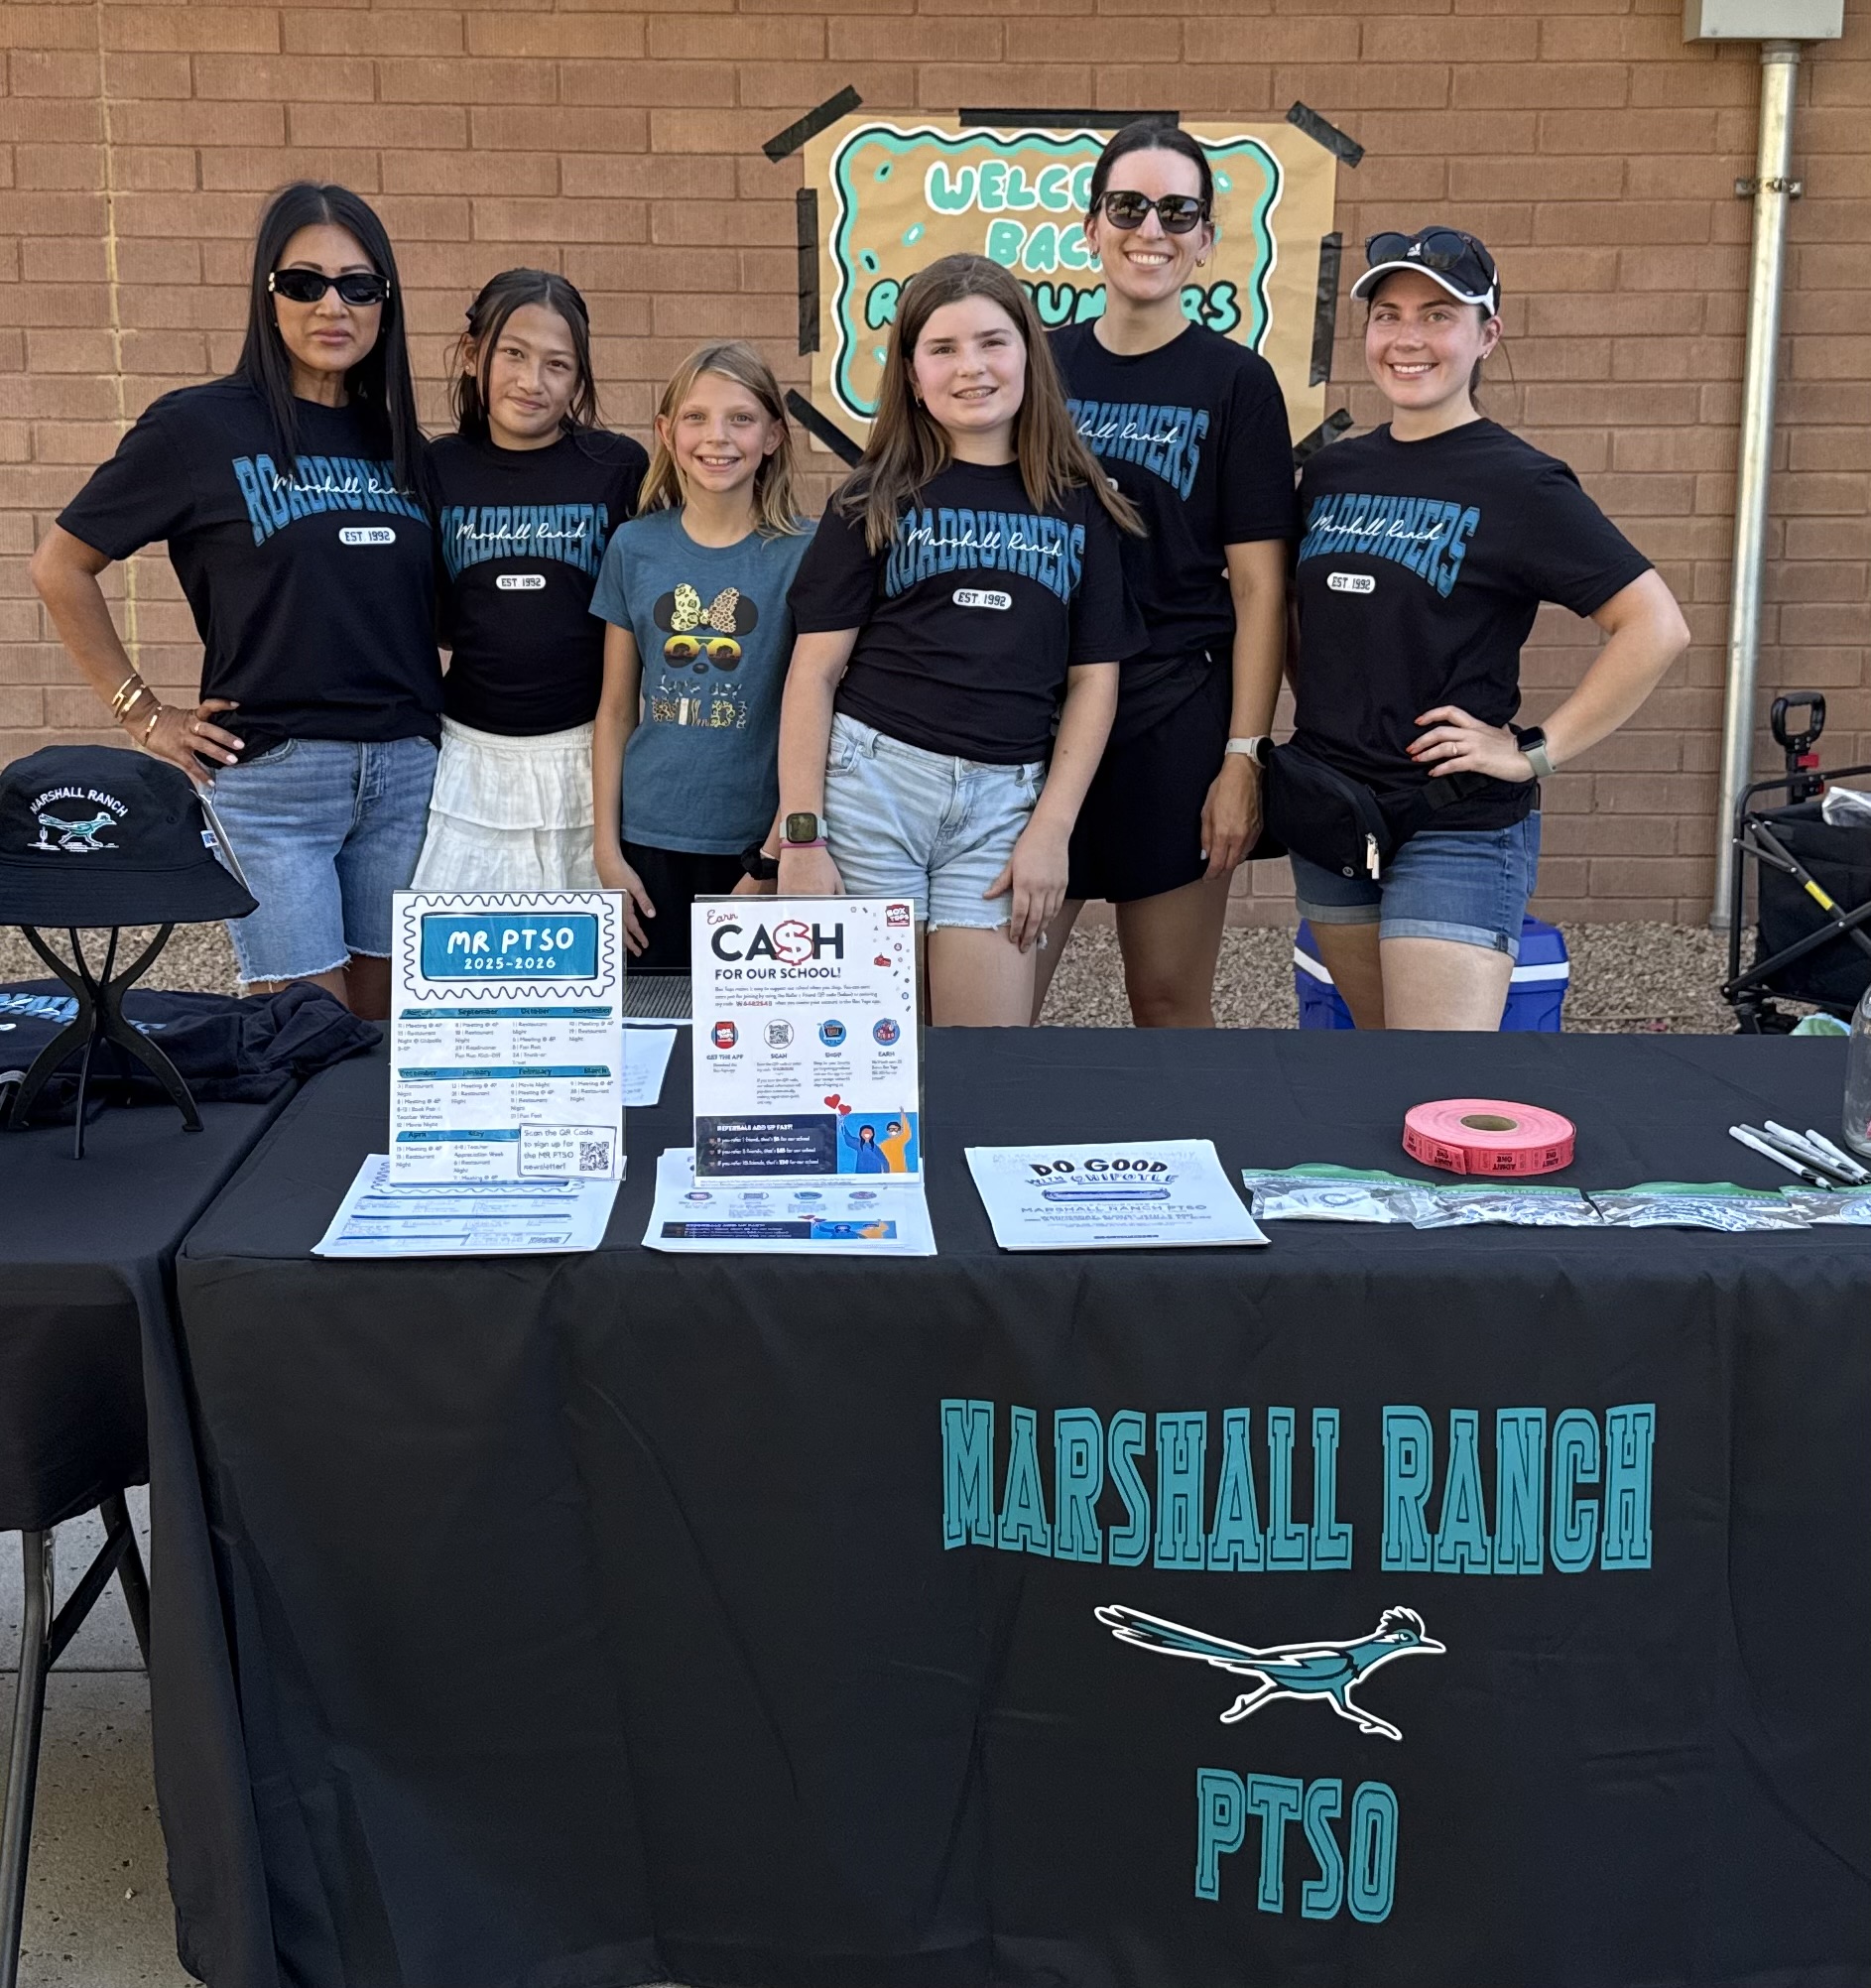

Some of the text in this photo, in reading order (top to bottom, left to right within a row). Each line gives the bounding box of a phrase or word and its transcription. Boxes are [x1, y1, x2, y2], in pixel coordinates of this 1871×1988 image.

[925, 160, 1095, 215] WELCO
[985, 218, 1103, 274] BAC
[1120, 423, 1179, 443] Ranch
[273, 473, 362, 494] Marshall
[369, 531, 390, 542] 1992
[456, 521, 586, 541] Marshall Ranch
[1310, 516, 1444, 541] Marshall Ranch
[907, 527, 1063, 557] Marshall Ranch
[523, 578, 542, 587] 1992
[1352, 577, 1370, 590] 1992
[984, 594, 1007, 607] 1992
[30, 787, 129, 817] MARSHALL RANCH
[706, 909, 738, 926] Earn
[446, 928, 574, 955] MR PTSO
[464, 956, 557, 970] 2025-2026
[714, 966, 841, 980] FOR OUR SCHOOL!
[1029, 1160, 1075, 1176] DO
[1084, 1159, 1169, 1173] GOOD
[1542, 1159, 1559, 1168] ADMIT
[1070, 1174, 1179, 1183] CHIPOTLE
[940, 1399, 1657, 1574] MARSHALL RANCH
[1193, 1768, 1399, 1924] PTSO
